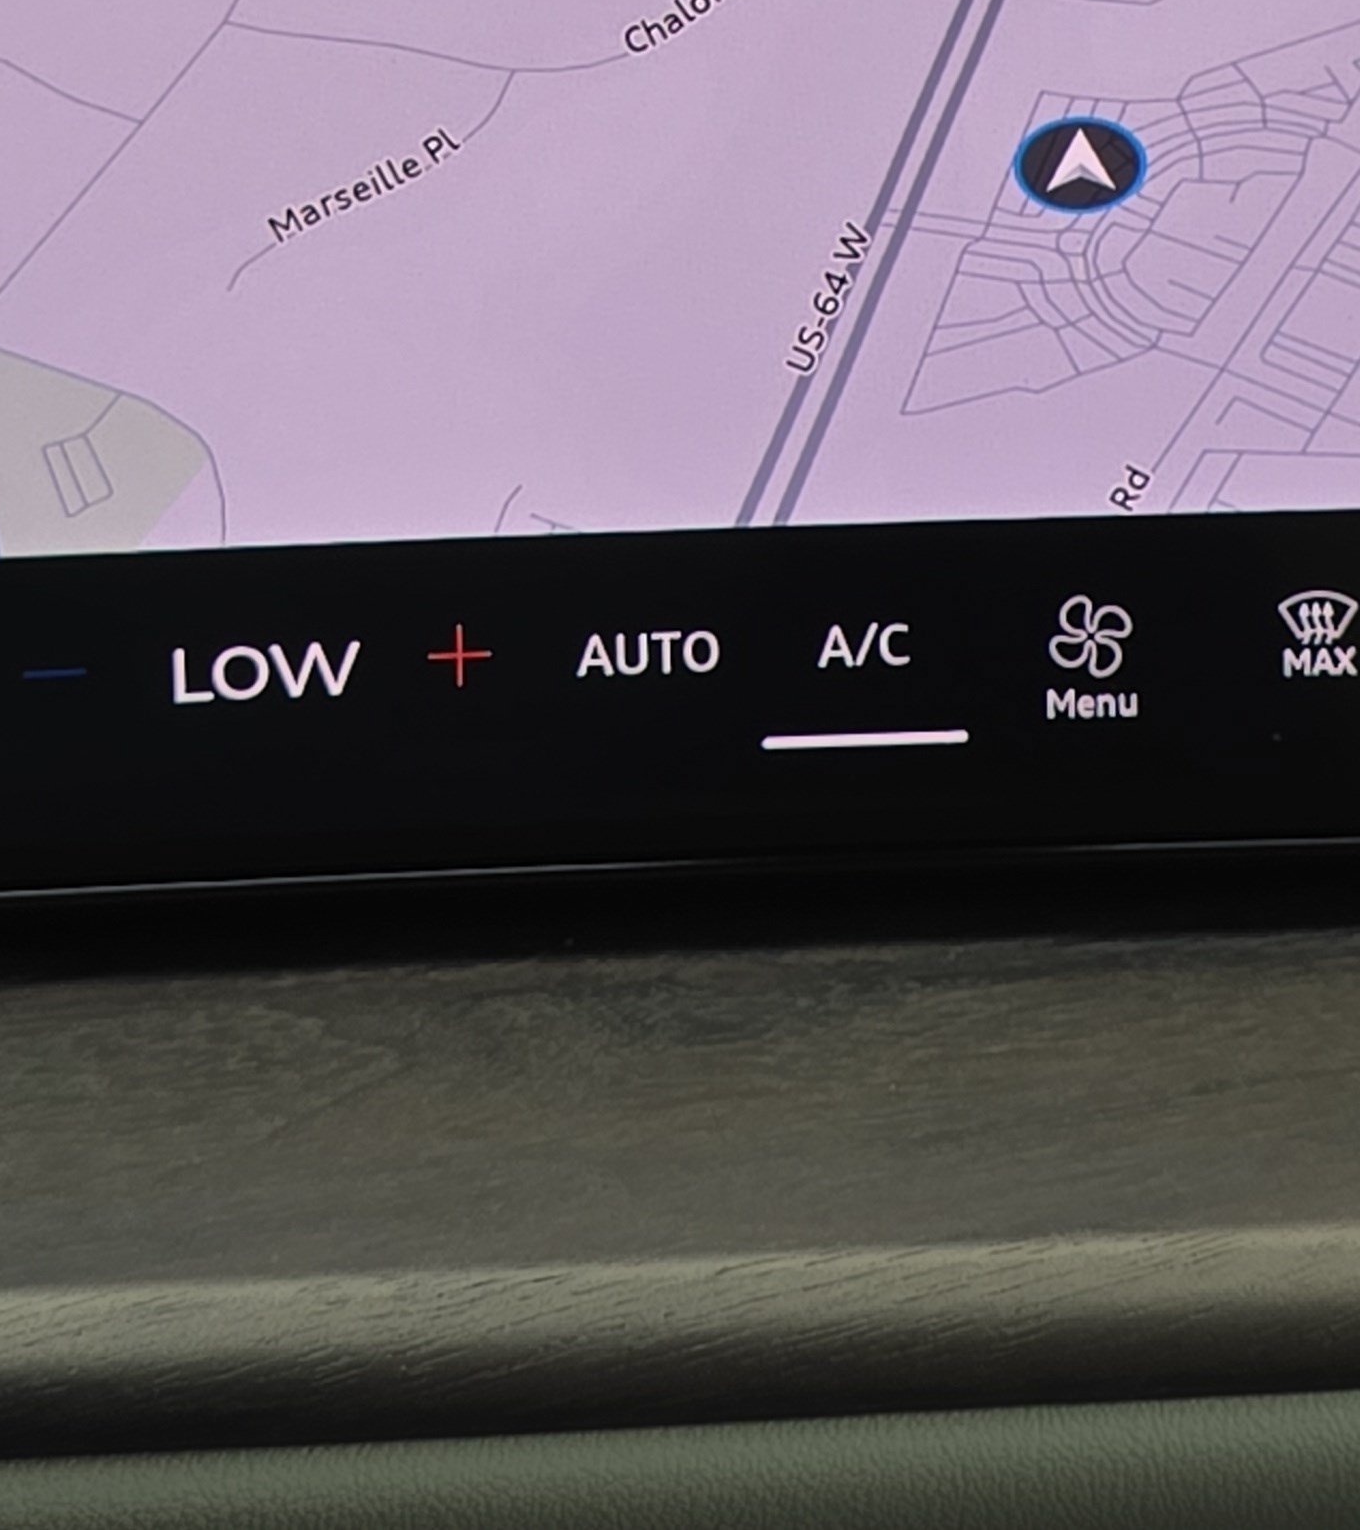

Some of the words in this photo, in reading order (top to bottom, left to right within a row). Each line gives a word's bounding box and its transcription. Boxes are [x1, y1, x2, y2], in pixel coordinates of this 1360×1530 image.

[266, 157, 423, 244] Marseille
[421, 128, 462, 166] Pl
[786, 270, 849, 373] US-64
[833, 222, 870, 263] W
[1109, 464, 1151, 512] Rd
[575, 629, 721, 677] AUTO
[816, 621, 912, 669] A/C
[1282, 645, 1359, 678] MAX
[171, 639, 362, 705] LOW
[1045, 687, 1139, 721] Menu
